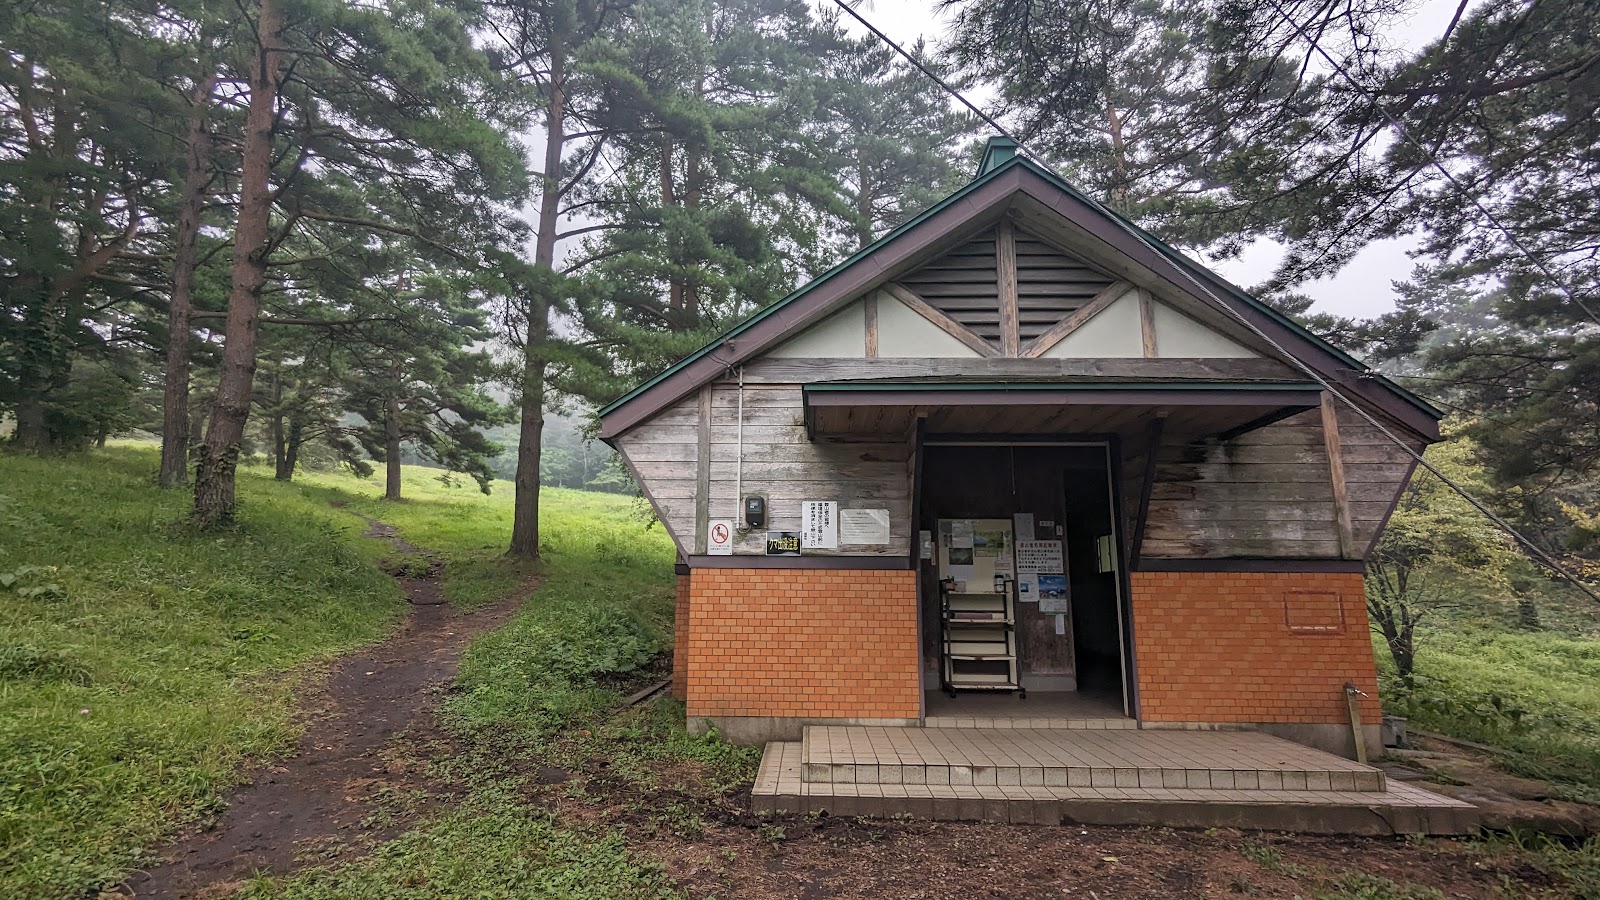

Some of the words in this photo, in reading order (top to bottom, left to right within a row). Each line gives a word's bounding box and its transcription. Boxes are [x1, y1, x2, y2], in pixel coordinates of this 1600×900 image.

[768, 536, 799, 551] クマ出没注意
